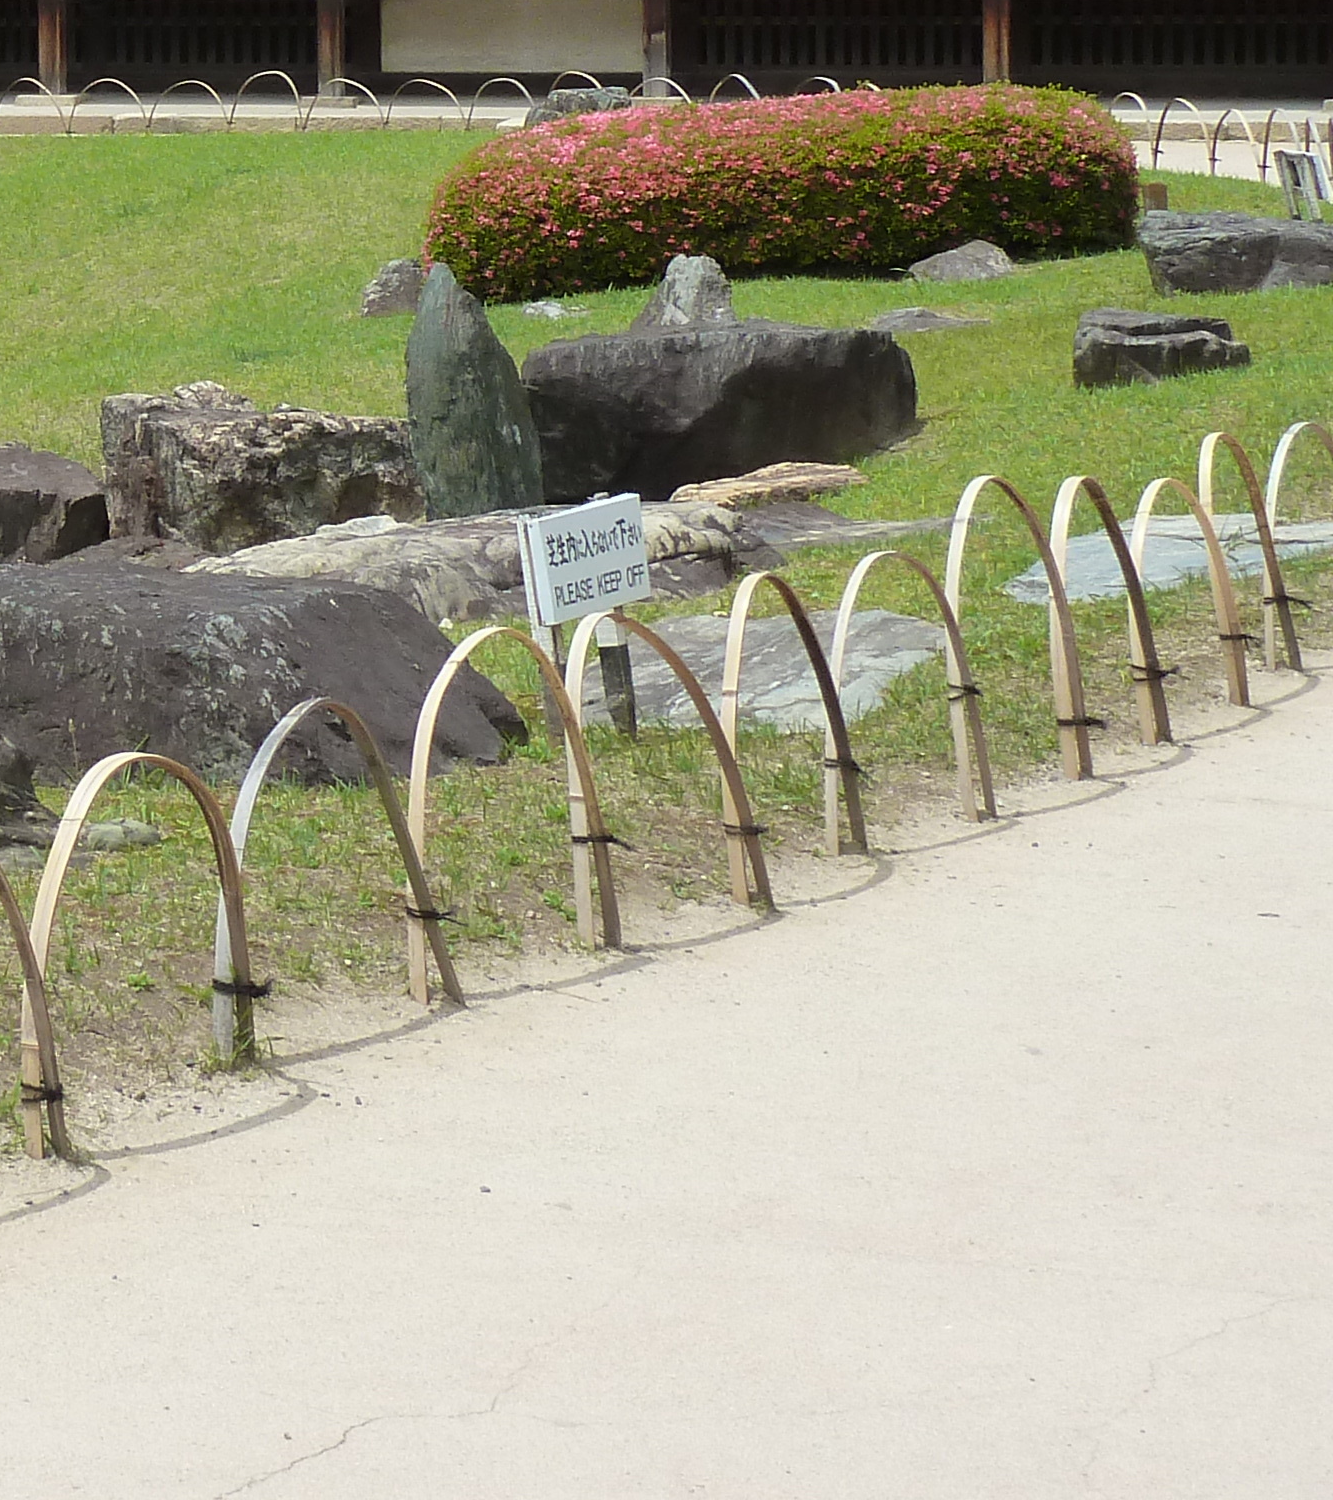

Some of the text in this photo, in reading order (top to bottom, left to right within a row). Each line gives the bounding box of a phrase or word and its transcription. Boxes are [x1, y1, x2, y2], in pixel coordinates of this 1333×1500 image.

[546, 518, 642, 567] 芝生内に入らないで下さい
[554, 563, 644, 608] PLEASE KEEP OFF
